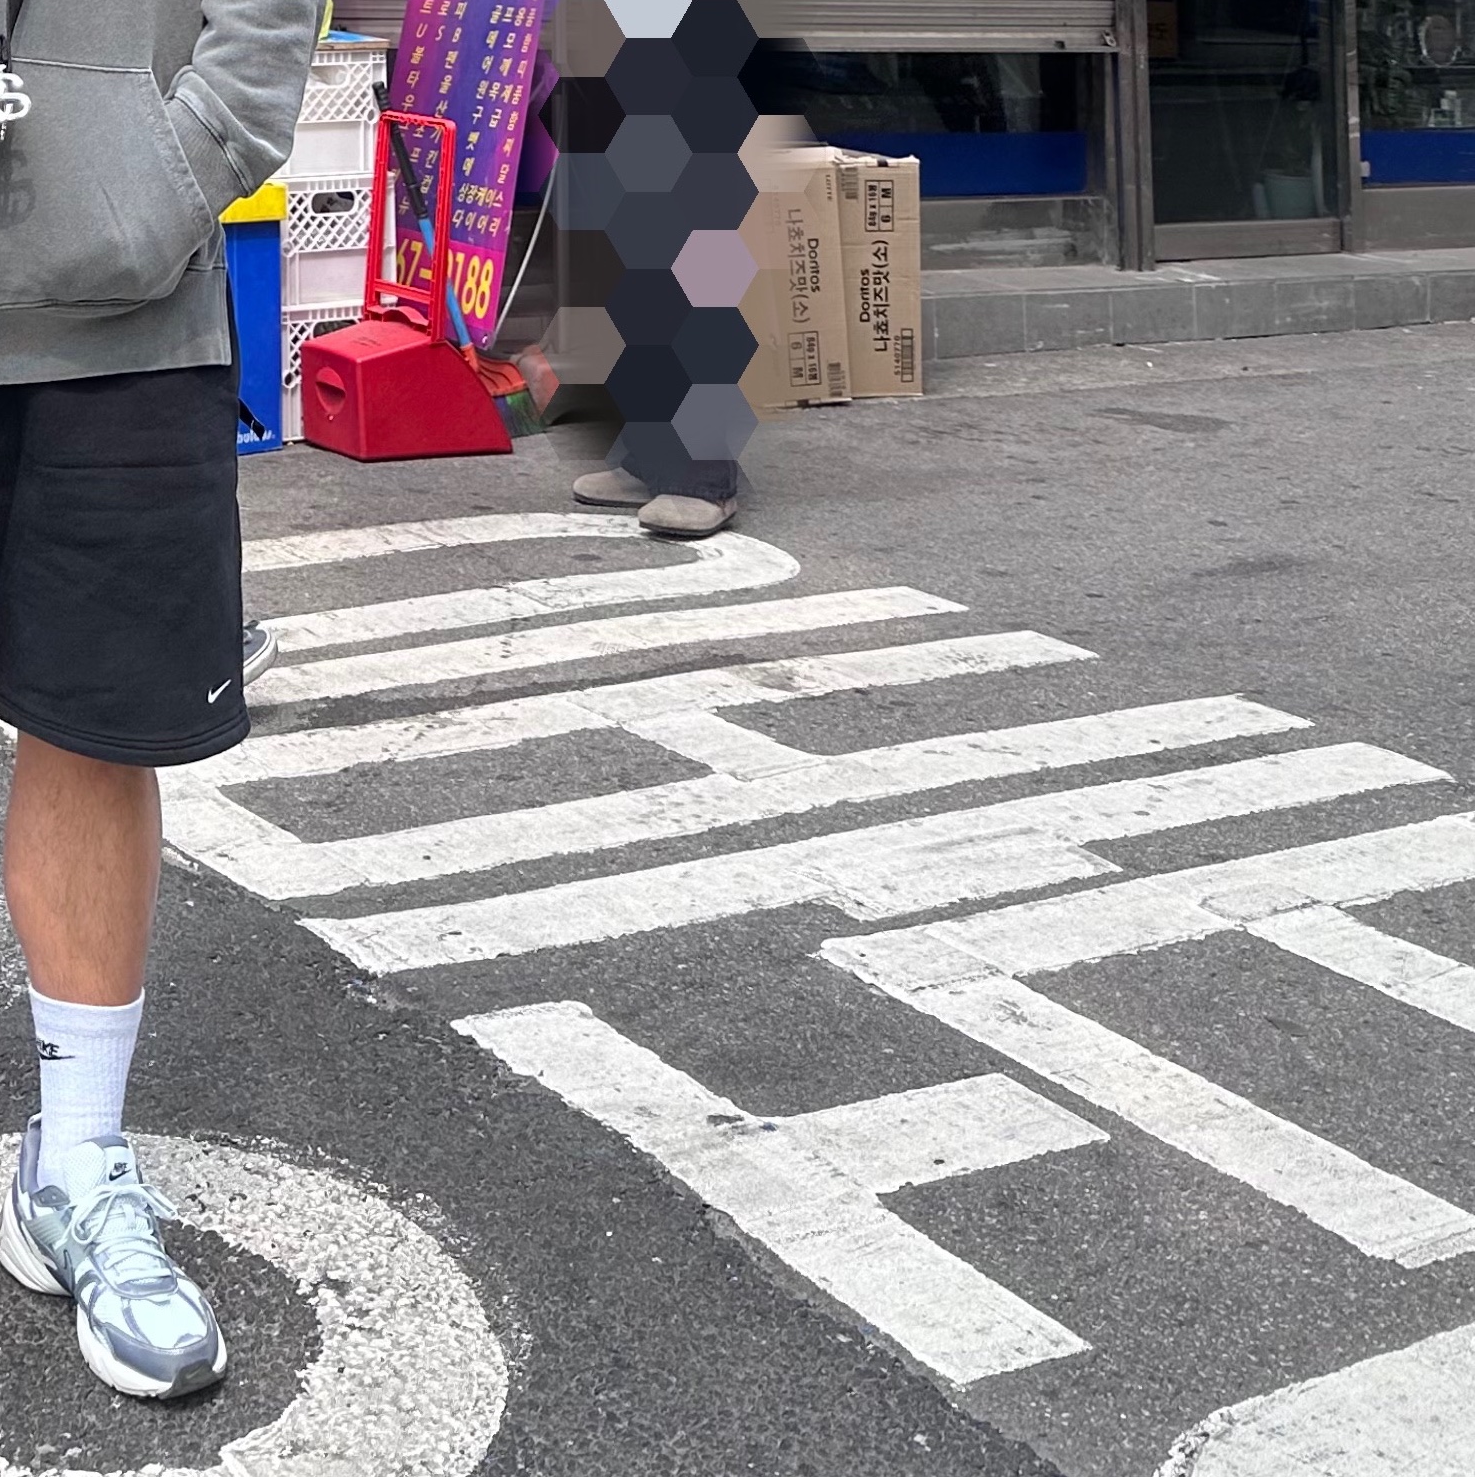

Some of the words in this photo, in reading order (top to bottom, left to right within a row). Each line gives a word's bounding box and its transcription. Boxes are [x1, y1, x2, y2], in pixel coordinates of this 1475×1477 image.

[881, 187, 892, 199] M
[806, 237, 821, 293] Doritos
[859, 268, 871, 323] Doritos
[871, 239, 891, 352] 나쵸치즈맛(소)
